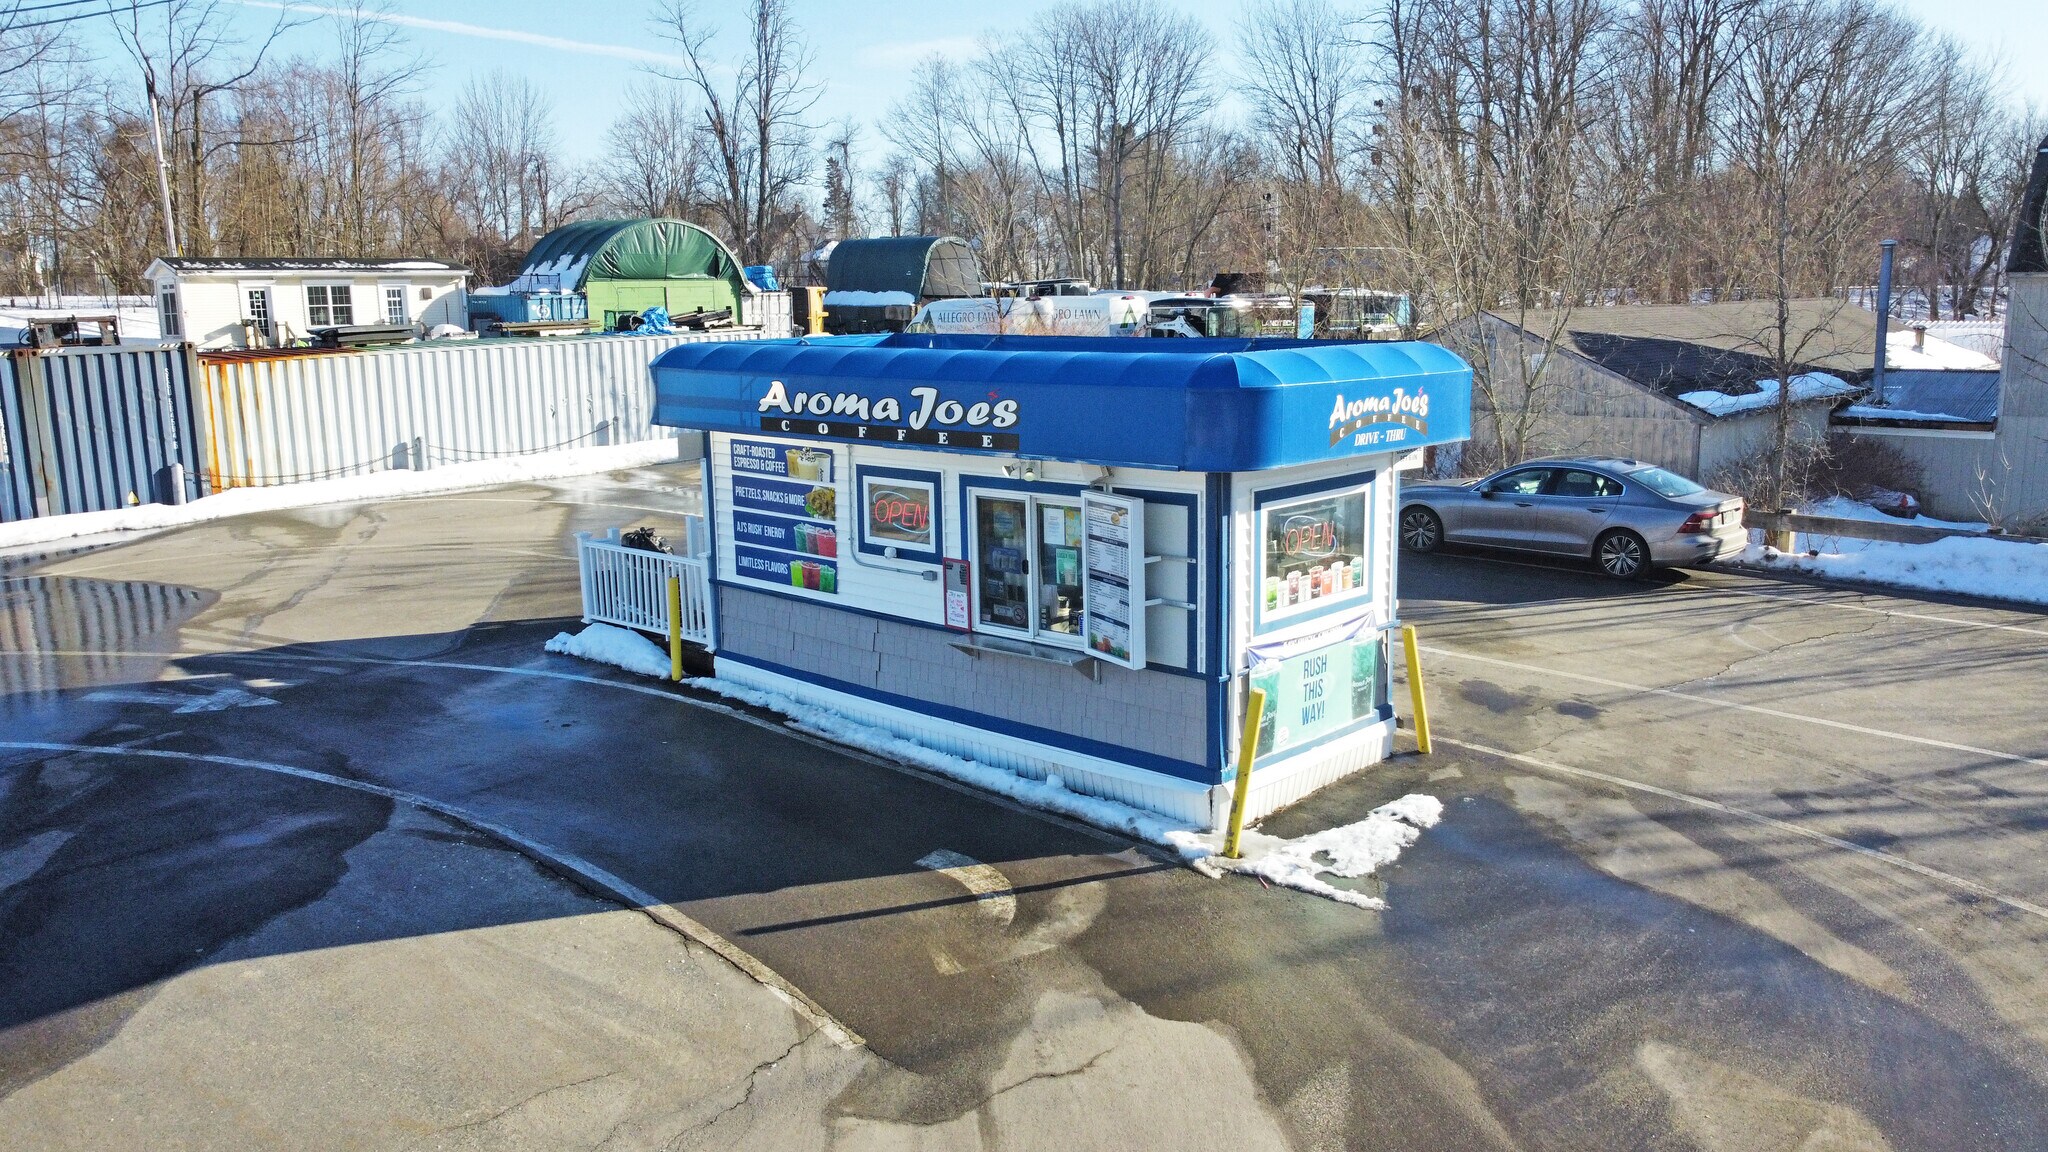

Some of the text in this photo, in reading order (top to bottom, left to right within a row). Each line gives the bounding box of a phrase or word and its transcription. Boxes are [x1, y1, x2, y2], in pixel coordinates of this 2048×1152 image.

[938, 311, 975, 323] ALLEGRO
[1074, 309, 1101, 320] LAWN
[758, 380, 902, 422] Aroma
[1329, 394, 1390, 430] Aroma
[780, 419, 994, 448] COFFEE
[1353, 431, 1380, 447] DRIVE
[1385, 428, 1407, 443] THRU
[733, 443, 776, 459] CRAFT-ROASTED
[734, 456, 786, 473] ESPRESSO & COFFEE
[762, 490, 784, 504] SNACKS
[784, 494, 789, 504] &
[788, 494, 806, 506] MORE
[874, 499, 929, 529] OPEN
[764, 525, 786, 540] ENERGY
[1285, 520, 1335, 556] OPEN
[738, 555, 789, 575] LIMITLESS FLAVORS
[1303, 653, 1328, 680] RUSH
[1303, 678, 1324, 703] THIS
[1301, 700, 1325, 726] WAY!
